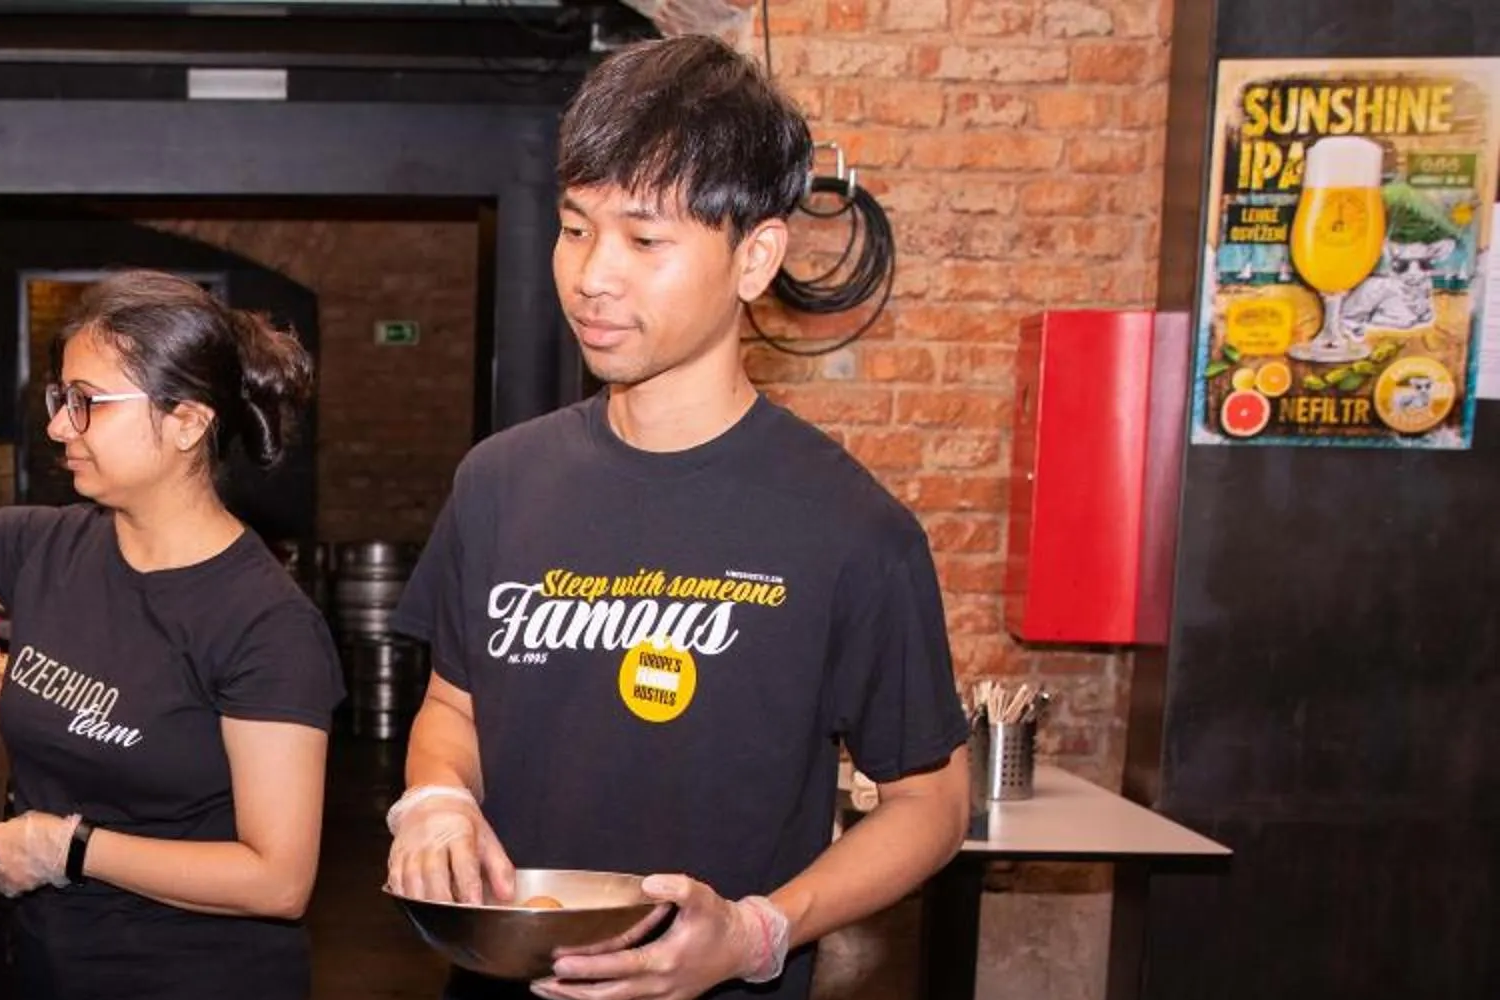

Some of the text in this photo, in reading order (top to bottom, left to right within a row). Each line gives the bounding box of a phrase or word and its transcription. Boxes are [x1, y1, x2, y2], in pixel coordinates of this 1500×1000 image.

[1241, 85, 1453, 137] SUNSHINE
[1278, 396, 1371, 425] NEFILTR
[540, 568, 610, 603] Sleep
[611, 568, 665, 598] with
[666, 573, 787, 608] someone
[487, 581, 739, 658] Famous
[68, 704, 144, 747] team
